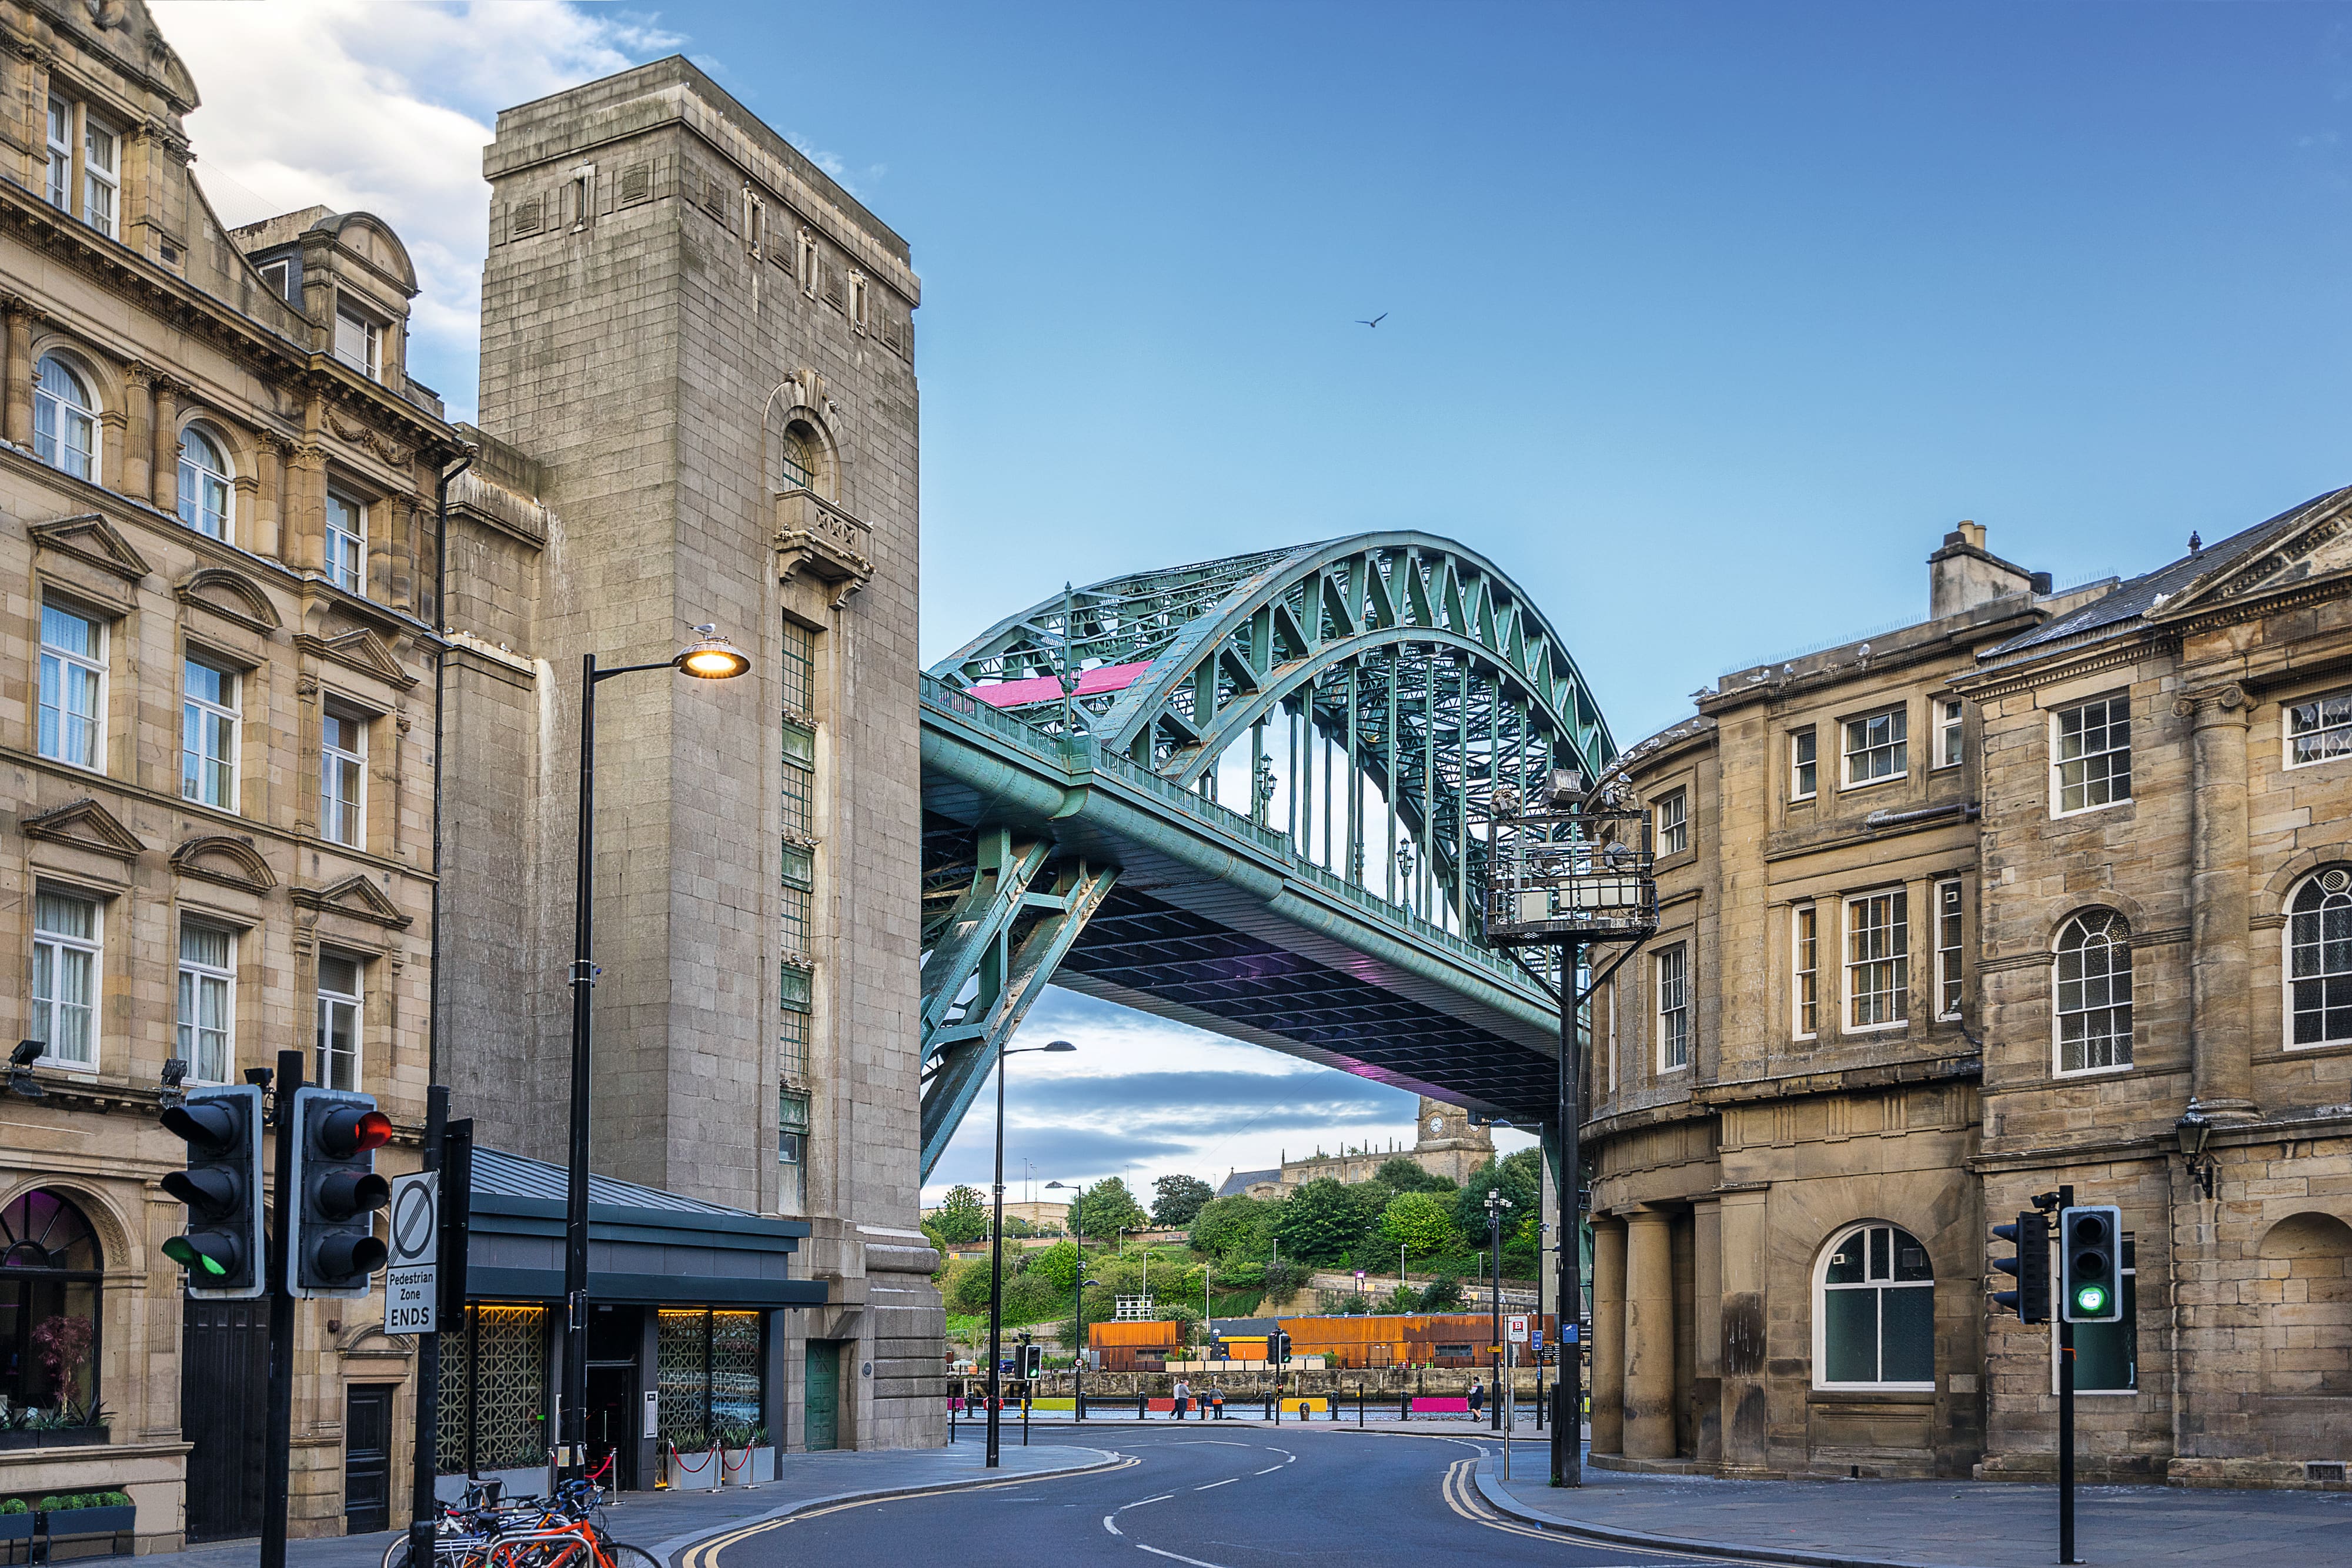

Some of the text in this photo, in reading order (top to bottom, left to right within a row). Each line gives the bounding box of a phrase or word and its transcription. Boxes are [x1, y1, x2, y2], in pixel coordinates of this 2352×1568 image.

[390, 1271, 433, 1286] Pedestrian
[400, 1288, 420, 1300] Zone
[391, 1306, 430, 1326] ENDS
